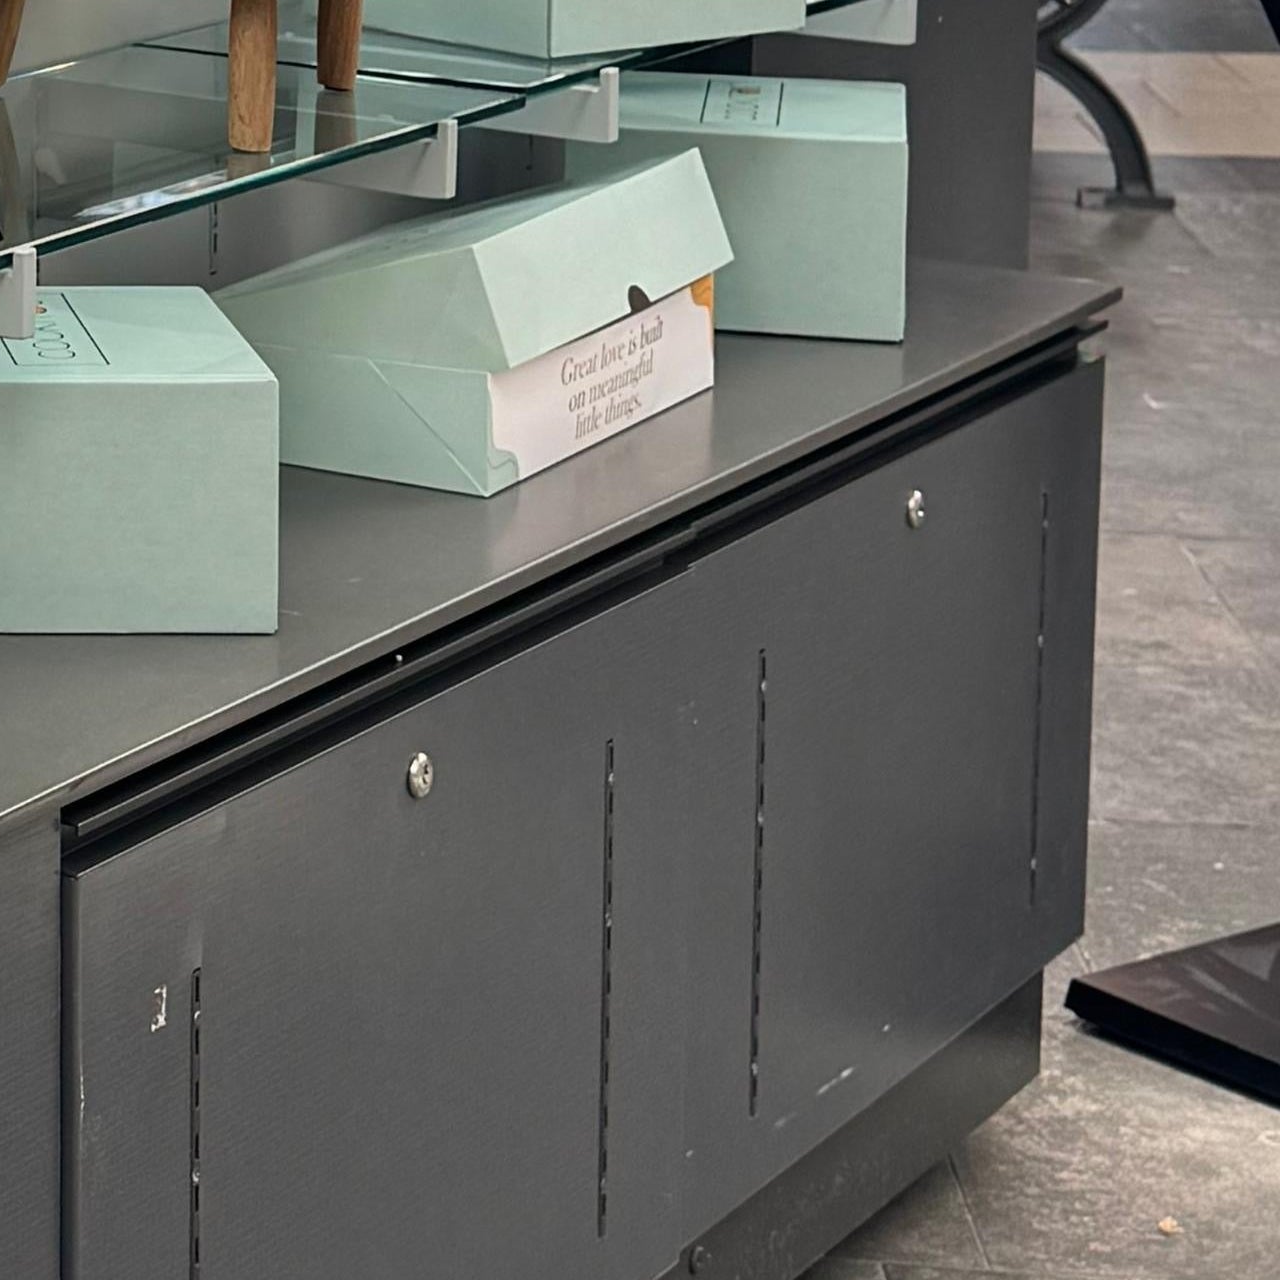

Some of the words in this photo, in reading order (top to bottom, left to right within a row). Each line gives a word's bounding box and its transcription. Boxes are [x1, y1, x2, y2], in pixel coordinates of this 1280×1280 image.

[560, 355, 597, 387] Great
[600, 342, 626, 372] love
[627, 328, 638, 357] is
[640, 314, 665, 350] built
[568, 388, 587, 413] on
[589, 350, 655, 406] meaningful
[575, 410, 602, 440] little
